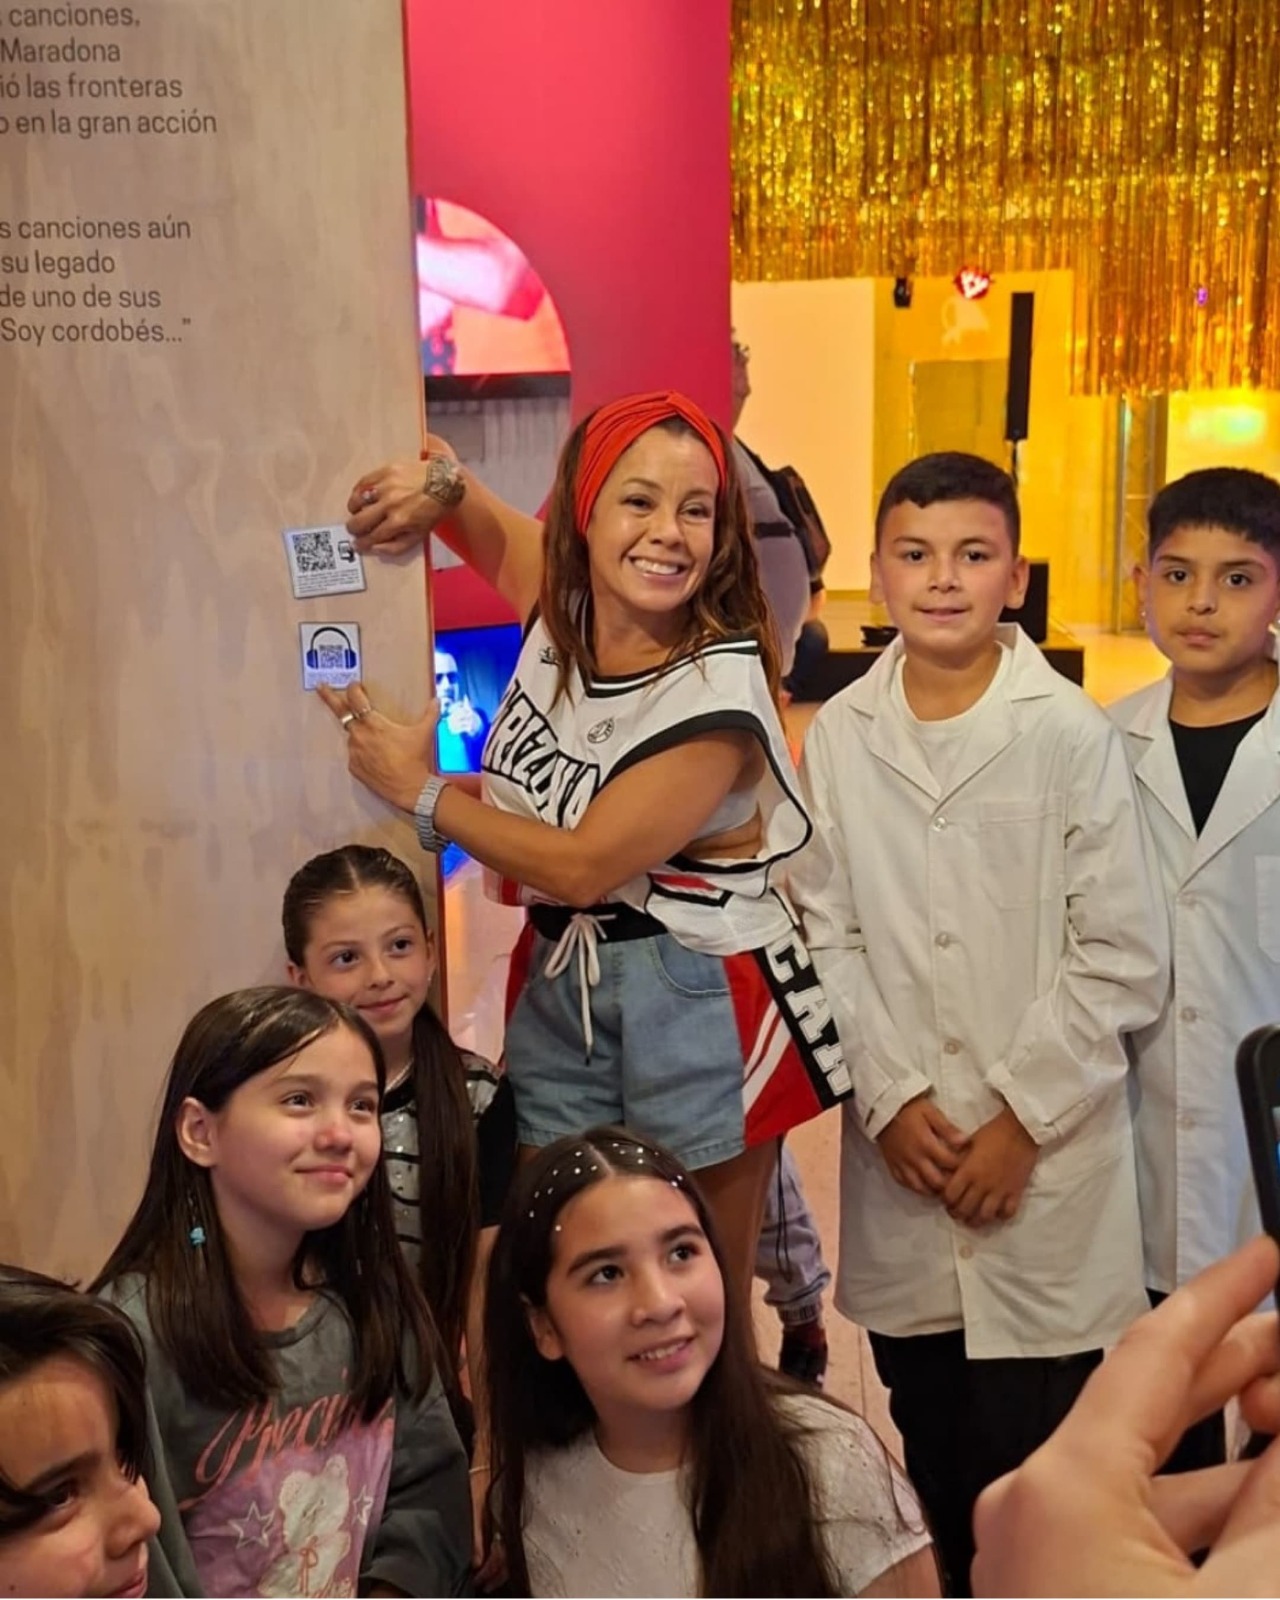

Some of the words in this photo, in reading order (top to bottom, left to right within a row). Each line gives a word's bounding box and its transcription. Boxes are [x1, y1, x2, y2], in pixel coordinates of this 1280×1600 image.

[0, 38, 120, 62] Maradona
[27, 75, 60, 98] las
[68, 72, 182, 98] fronteras
[17, 115, 45, 134] en
[52, 110, 71, 134] la
[78, 115, 130, 139] gran
[138, 110, 217, 134] acción
[19, 217, 141, 239] canciones
[148, 215, 191, 239] aún
[2, 255, 28, 273] su
[36, 250, 115, 278] legado
[0, 286, 25, 307] de
[33, 288, 75, 307] uno
[83, 284, 112, 307] de
[119, 288, 161, 307] sus
[1, 318, 44, 346] Soy
